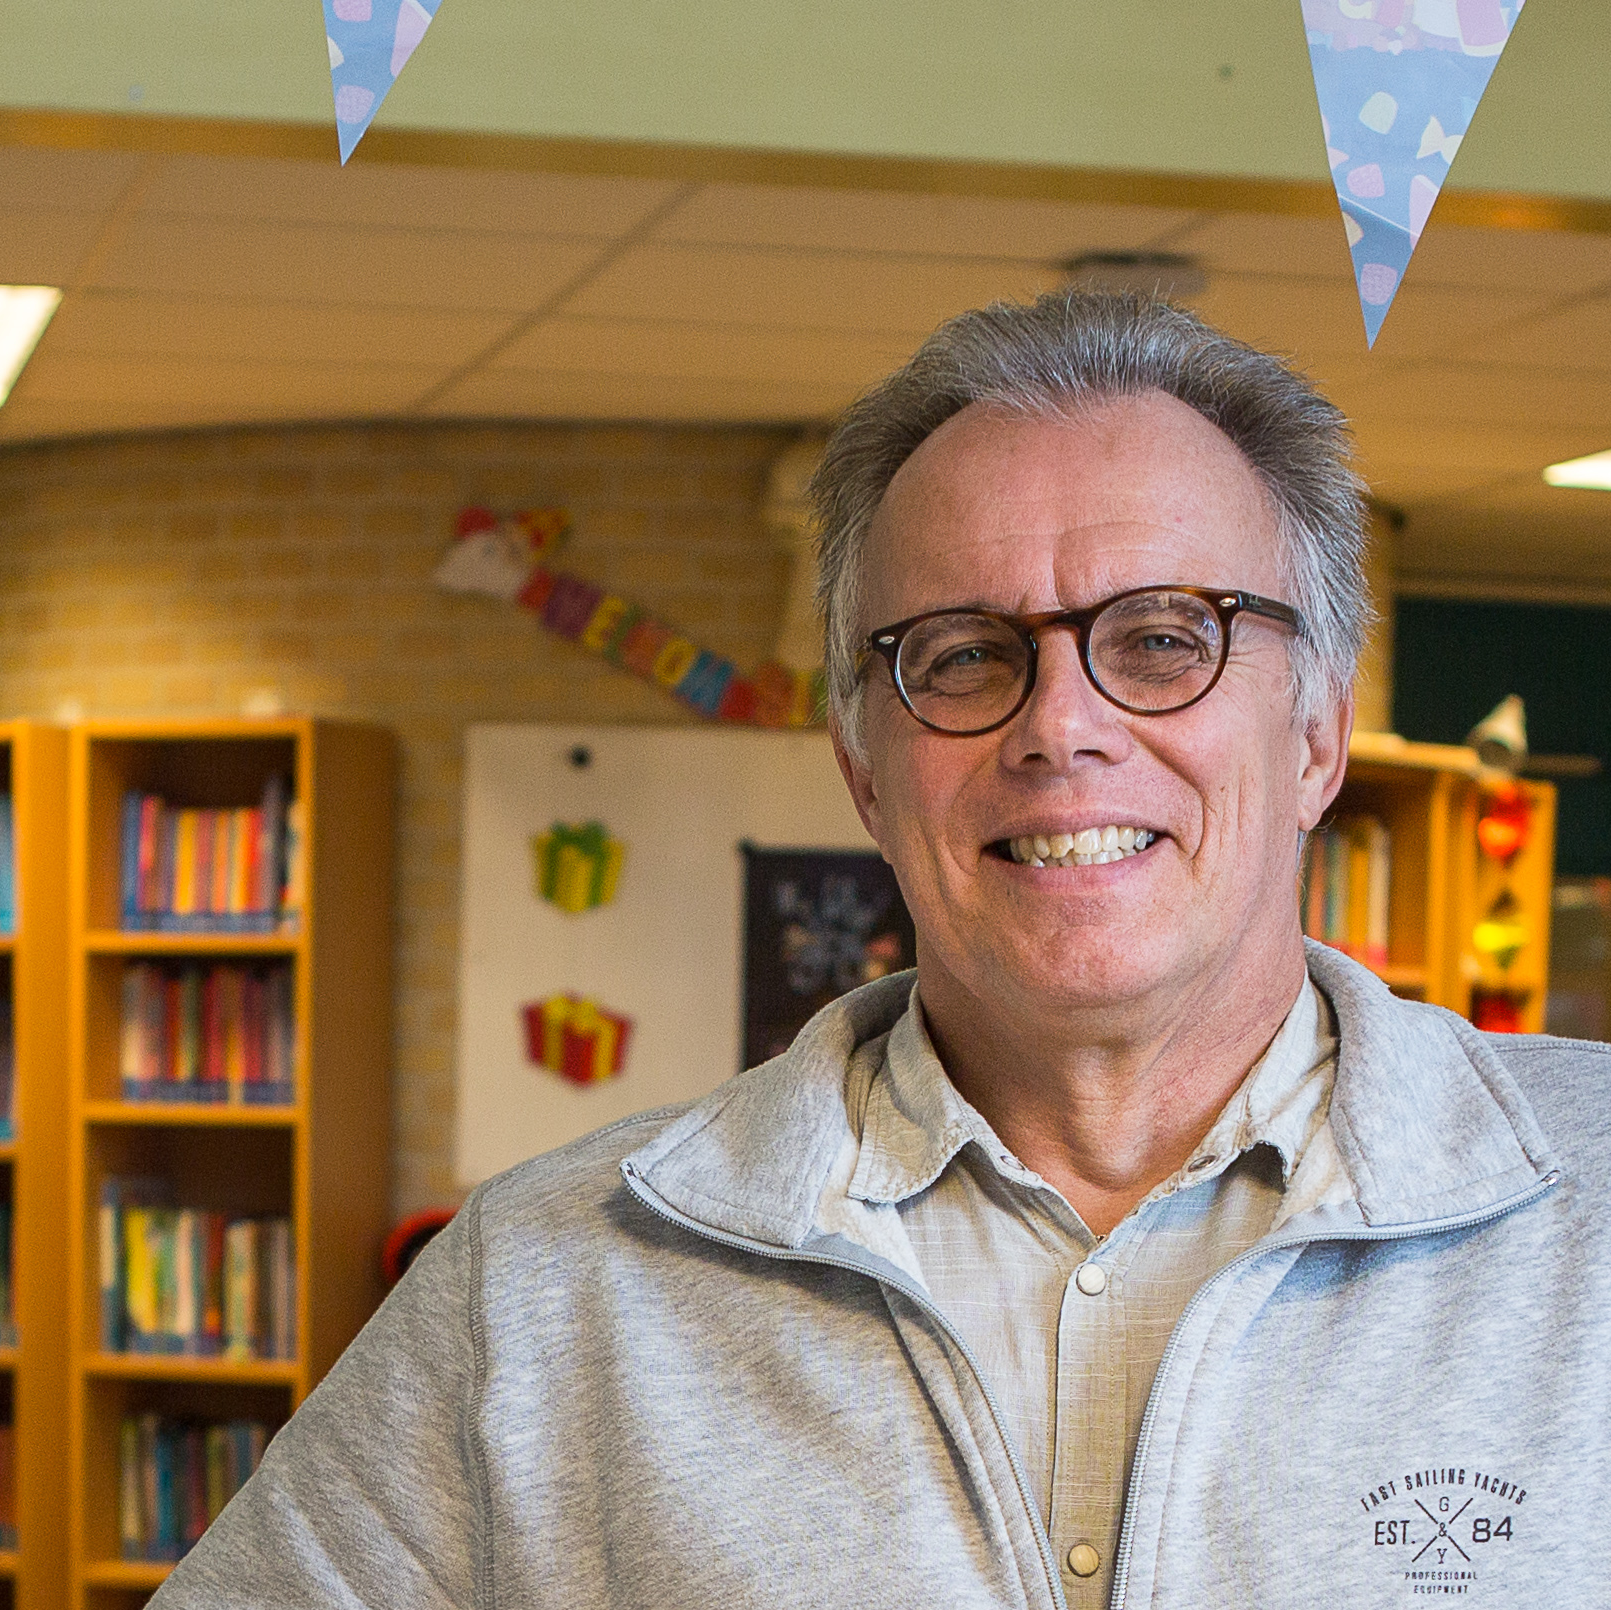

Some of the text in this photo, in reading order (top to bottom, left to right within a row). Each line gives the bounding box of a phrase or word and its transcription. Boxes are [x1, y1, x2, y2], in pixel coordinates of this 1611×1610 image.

[1360, 1468, 1528, 1512] FAST SAILING YACHTS
[1374, 1515, 1514, 1546] EST. 84
[1436, 1496, 1450, 1565] G & Y
[1404, 1570, 1478, 1581] PROFESSIONAL
[1413, 1584, 1470, 1595] EQUIPMENT
